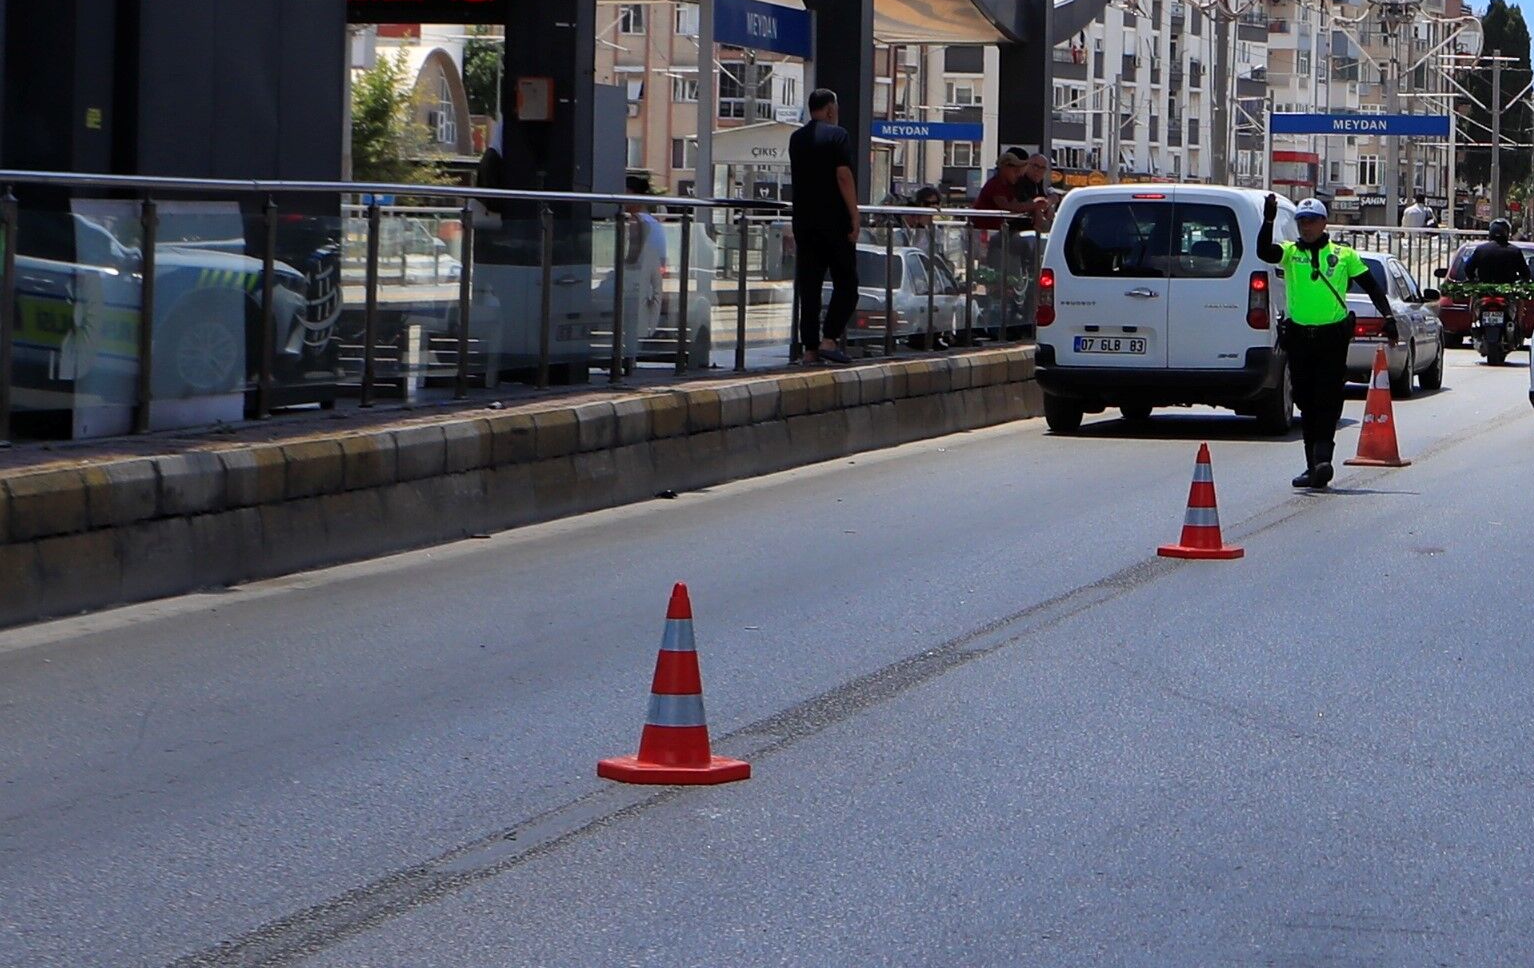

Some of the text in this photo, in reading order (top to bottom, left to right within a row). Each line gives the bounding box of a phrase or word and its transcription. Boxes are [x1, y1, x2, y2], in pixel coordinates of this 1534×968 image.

[746, 12, 778, 39] MEYDAN
[882, 125, 929, 135] MEYDAN
[1333, 119, 1387, 130] MEYDAN
[752, 147, 777, 158] ÇIKIŞ
[1081, 339, 1144, 352] 07 GLB 83
